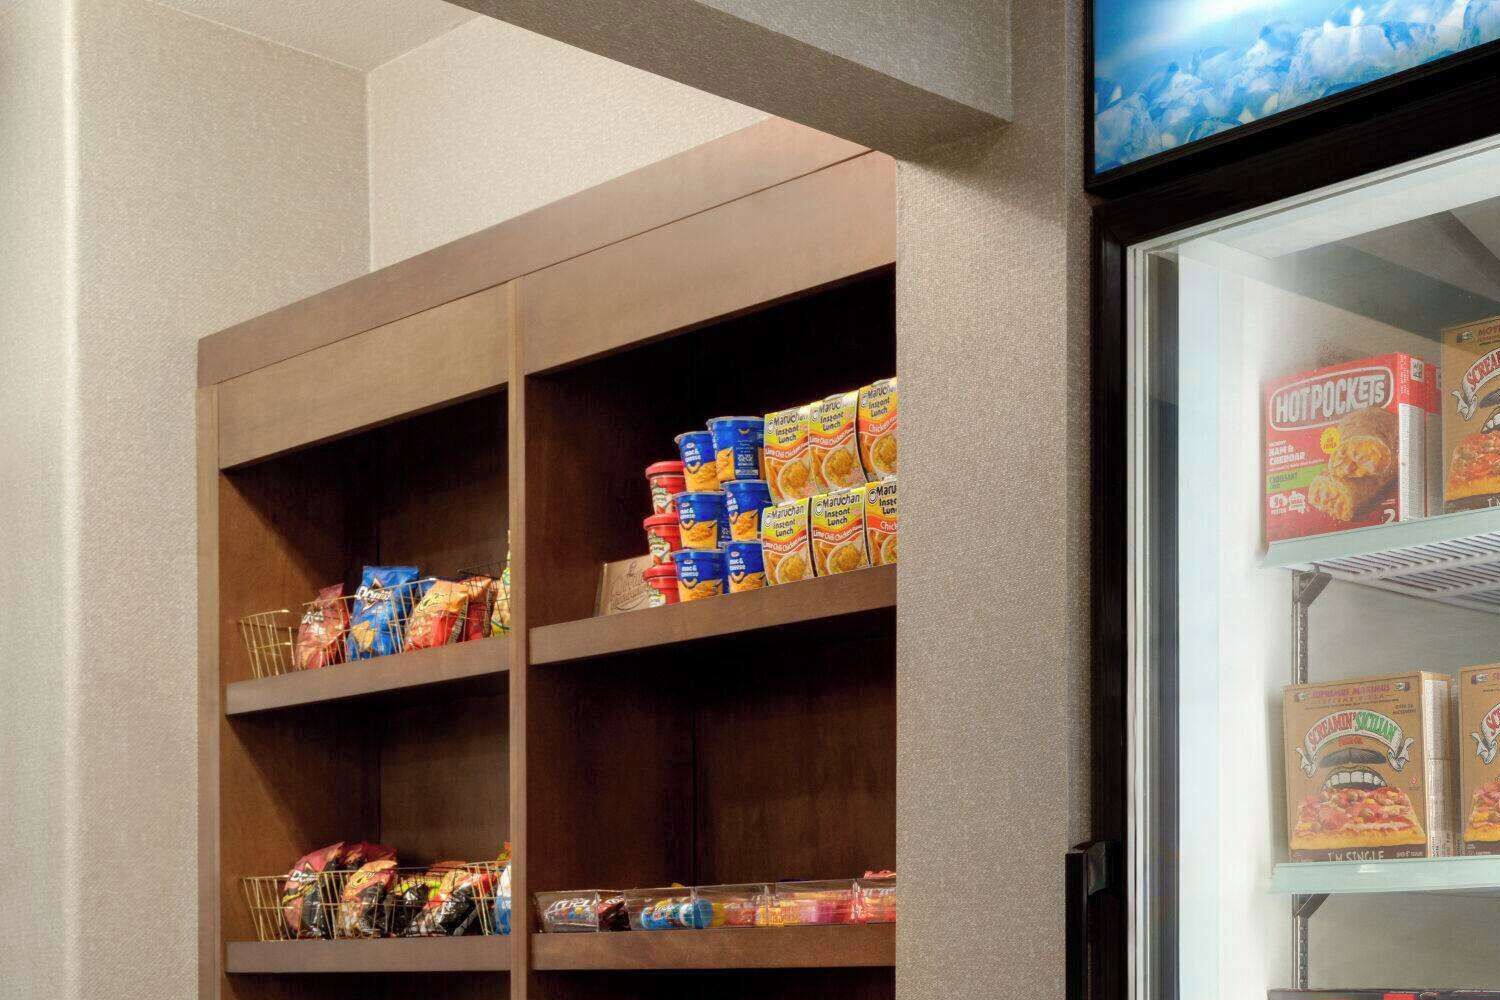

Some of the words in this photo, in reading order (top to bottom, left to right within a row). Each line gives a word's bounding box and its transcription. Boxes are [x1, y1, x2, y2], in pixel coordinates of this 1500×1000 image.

[1276, 387, 1310, 423] HOT
[1309, 374, 1386, 419] POCKETS
[822, 421, 841, 432] Lunch
[778, 435, 797, 445] Lunch
[822, 494, 860, 508] Maruchan
[824, 507, 850, 518] Instant
[827, 516, 848, 527] Lunch
[775, 528, 794, 538] Lunch
[1346, 850, 1384, 862] SINGLE
